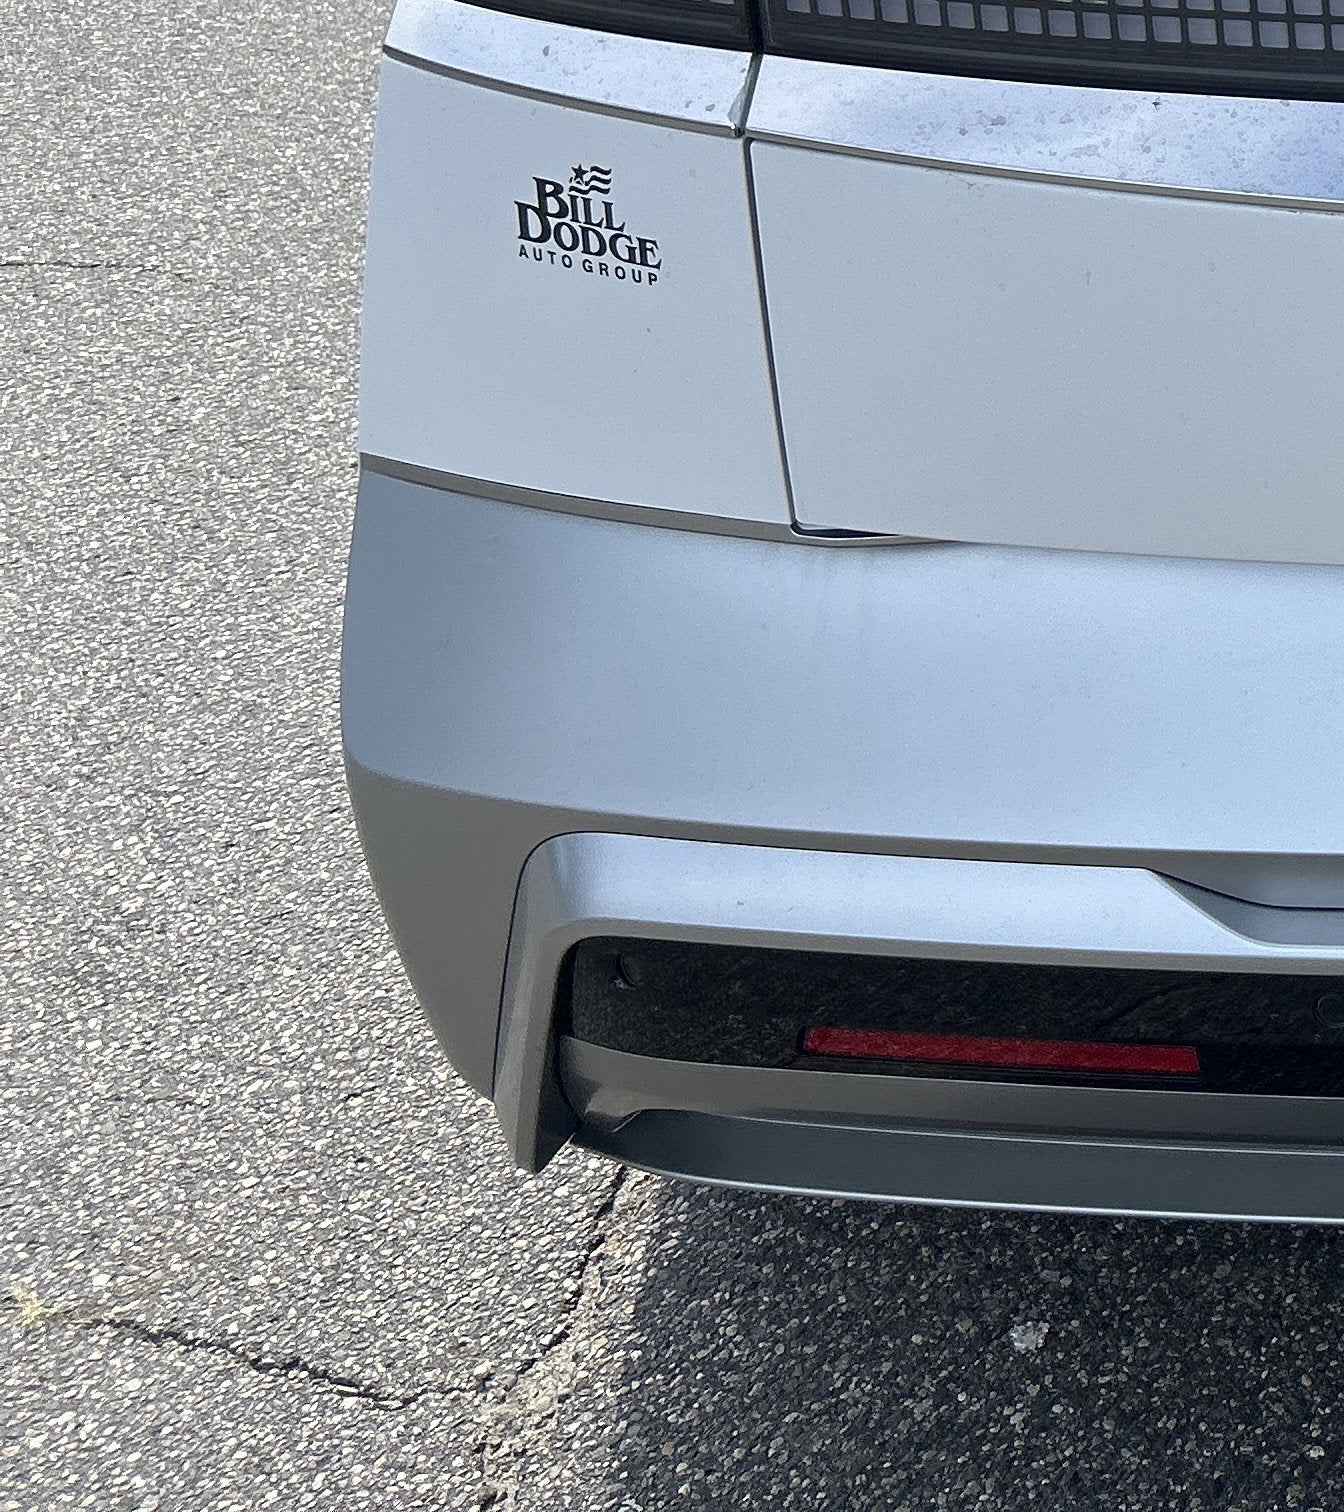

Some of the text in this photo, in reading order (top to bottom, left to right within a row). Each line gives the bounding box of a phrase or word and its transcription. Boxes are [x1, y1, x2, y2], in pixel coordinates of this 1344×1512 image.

[532, 176, 626, 232] BILL
[514, 200, 662, 270] DODGE
[519, 244, 658, 286] AUTO GROUP
